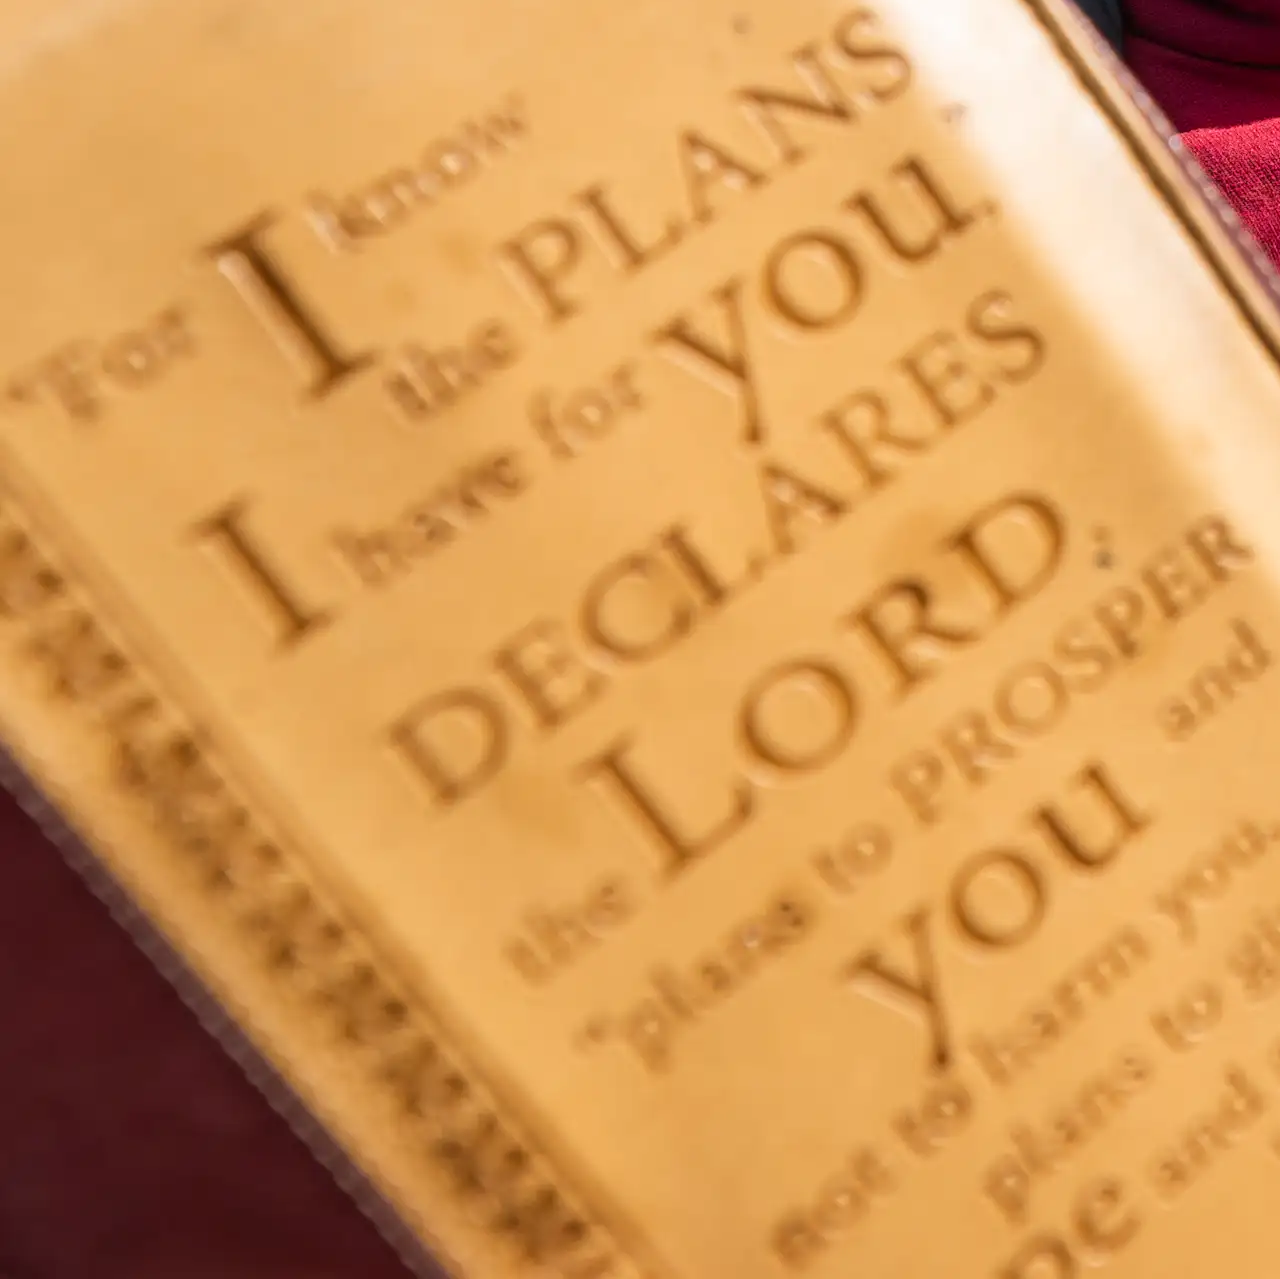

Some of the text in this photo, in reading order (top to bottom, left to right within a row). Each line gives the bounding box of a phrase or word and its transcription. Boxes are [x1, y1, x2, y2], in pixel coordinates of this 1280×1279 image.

[201, 208, 378, 402] I
[306, 95, 528, 250] know
[384, 8, 912, 418] the PLANS
[192, 496, 334, 652] I
[328, 451, 529, 586] have
[531, 364, 643, 461] for
[384, 287, 1046, 806] DECLARES
[814, 819, 895, 898] to
[888, 515, 1256, 825] PROSPER
[844, 760, 1153, 1072] you
[1166, 616, 1273, 745] and
[500, 870, 640, 985] the
[768, 1146, 897, 1268] not
[898, 1081, 974, 1160] to
[966, 928, 1153, 1086] harm
[981, 1044, 1153, 1227] plans
[1150, 980, 1226, 1057] to
[1148, 1060, 1265, 1200] and
